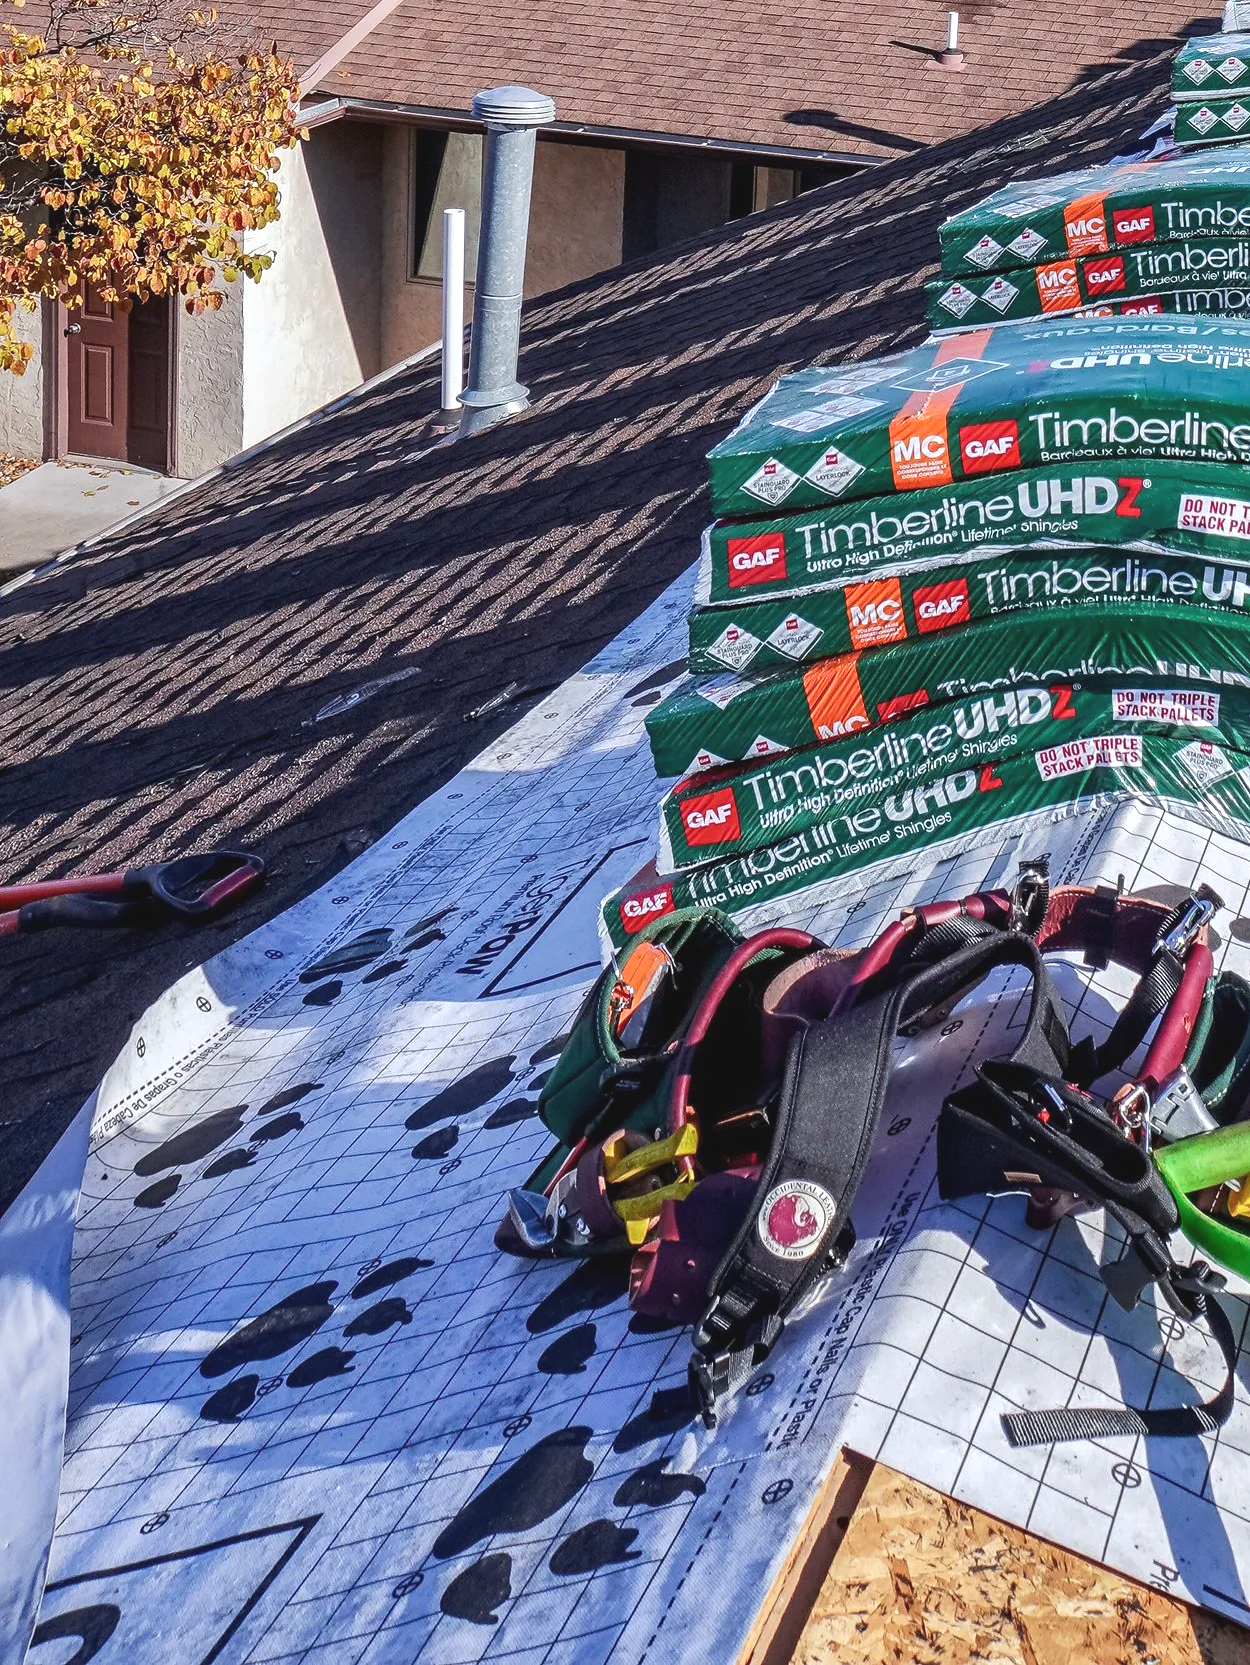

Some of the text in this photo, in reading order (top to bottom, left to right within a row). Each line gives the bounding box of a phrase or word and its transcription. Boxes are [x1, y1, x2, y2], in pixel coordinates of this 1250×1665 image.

[1067, 216, 1106, 238] MC
[1117, 217, 1151, 233] GAF
[1037, 267, 1077, 289] MC
[1087, 268, 1121, 284] GAF
[1140, 273, 1191, 288] Bardeaux
[1223, 269, 1248, 281] Ultra
[894, 435, 945, 463] MC
[965, 436, 1014, 459] GAF
[815, 468, 851, 482] LAYERLOCK
[1184, 499, 1201, 513] DO
[1208, 501, 1237, 517] NOT
[732, 547, 780, 570] GAF
[795, 495, 1014, 559] Timberline
[1181, 514, 1226, 532] STACK
[806, 547, 881, 574] Ultra High
[851, 599, 902, 626] MC
[918, 595, 964, 619] GAF
[978, 559, 1197, 605] Timberline
[1116, 692, 1216, 708] DO NOT TRIPLE
[1116, 704, 1215, 722] STACK PALLETS
[1040, 737, 1140, 765] DO NOT TRIPLE
[1043, 749, 1140, 778] STACK PALLETS
[686, 803, 733, 829] GAF
[743, 723, 953, 811] Timberline
[760, 808, 795, 829] Ultra
[797, 791, 832, 816] High
[694, 809, 953, 908] Ultra High Shingles
[623, 891, 670, 918] GAF
[145, 1077, 179, 1104] Grapas
[131, 1097, 148, 1114] De
[104, 1106, 134, 1134] Cabeza
[765, 1181, 818, 1206] OCCIDENTAL
[852, 1256, 891, 1306] Plastic
[833, 1305, 863, 1336] Cap
[815, 1334, 848, 1375] Nails
[808, 1376, 824, 1395] or
